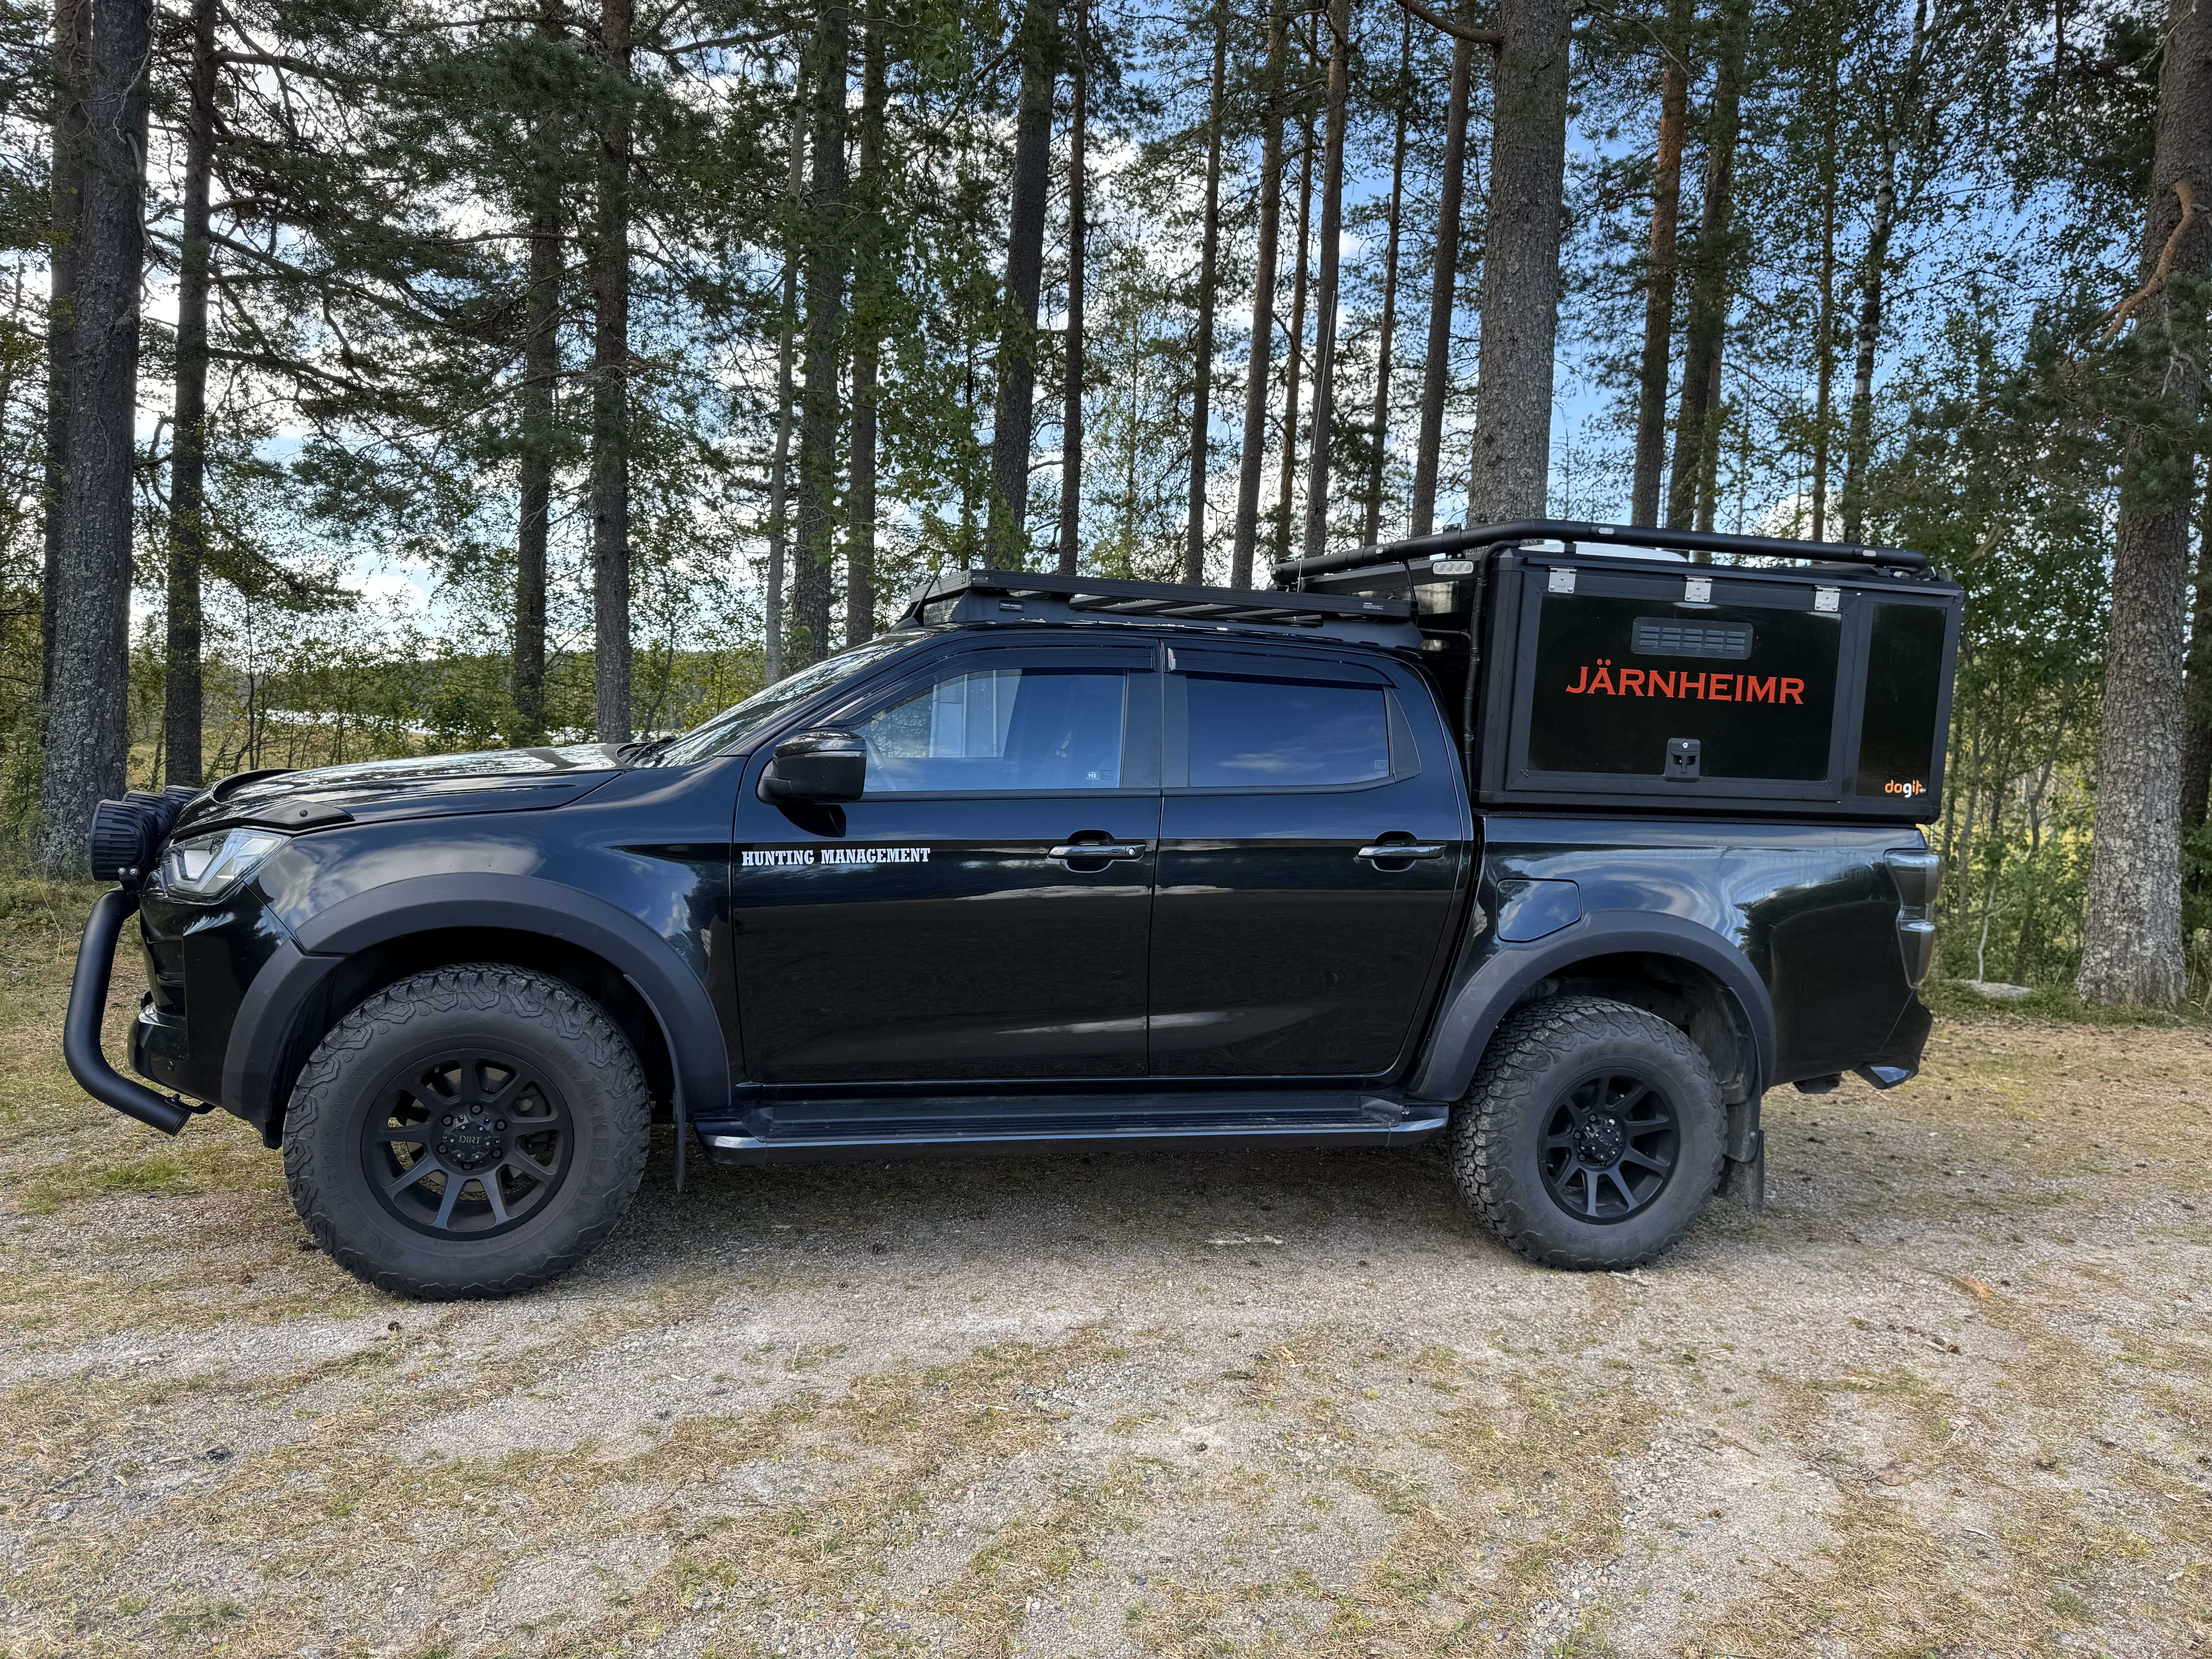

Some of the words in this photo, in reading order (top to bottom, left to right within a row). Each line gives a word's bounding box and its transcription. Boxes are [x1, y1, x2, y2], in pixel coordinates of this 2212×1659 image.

[1566, 659, 1804, 704] JÄRNHEIMR
[1885, 779, 1922, 798] dogit
[742, 850, 814, 866] HUNTING
[821, 848, 931, 864] MANAGEMENT
[459, 1135, 482, 1144] DIRT
[547, 1043, 609, 1219] BLACKBEAR
